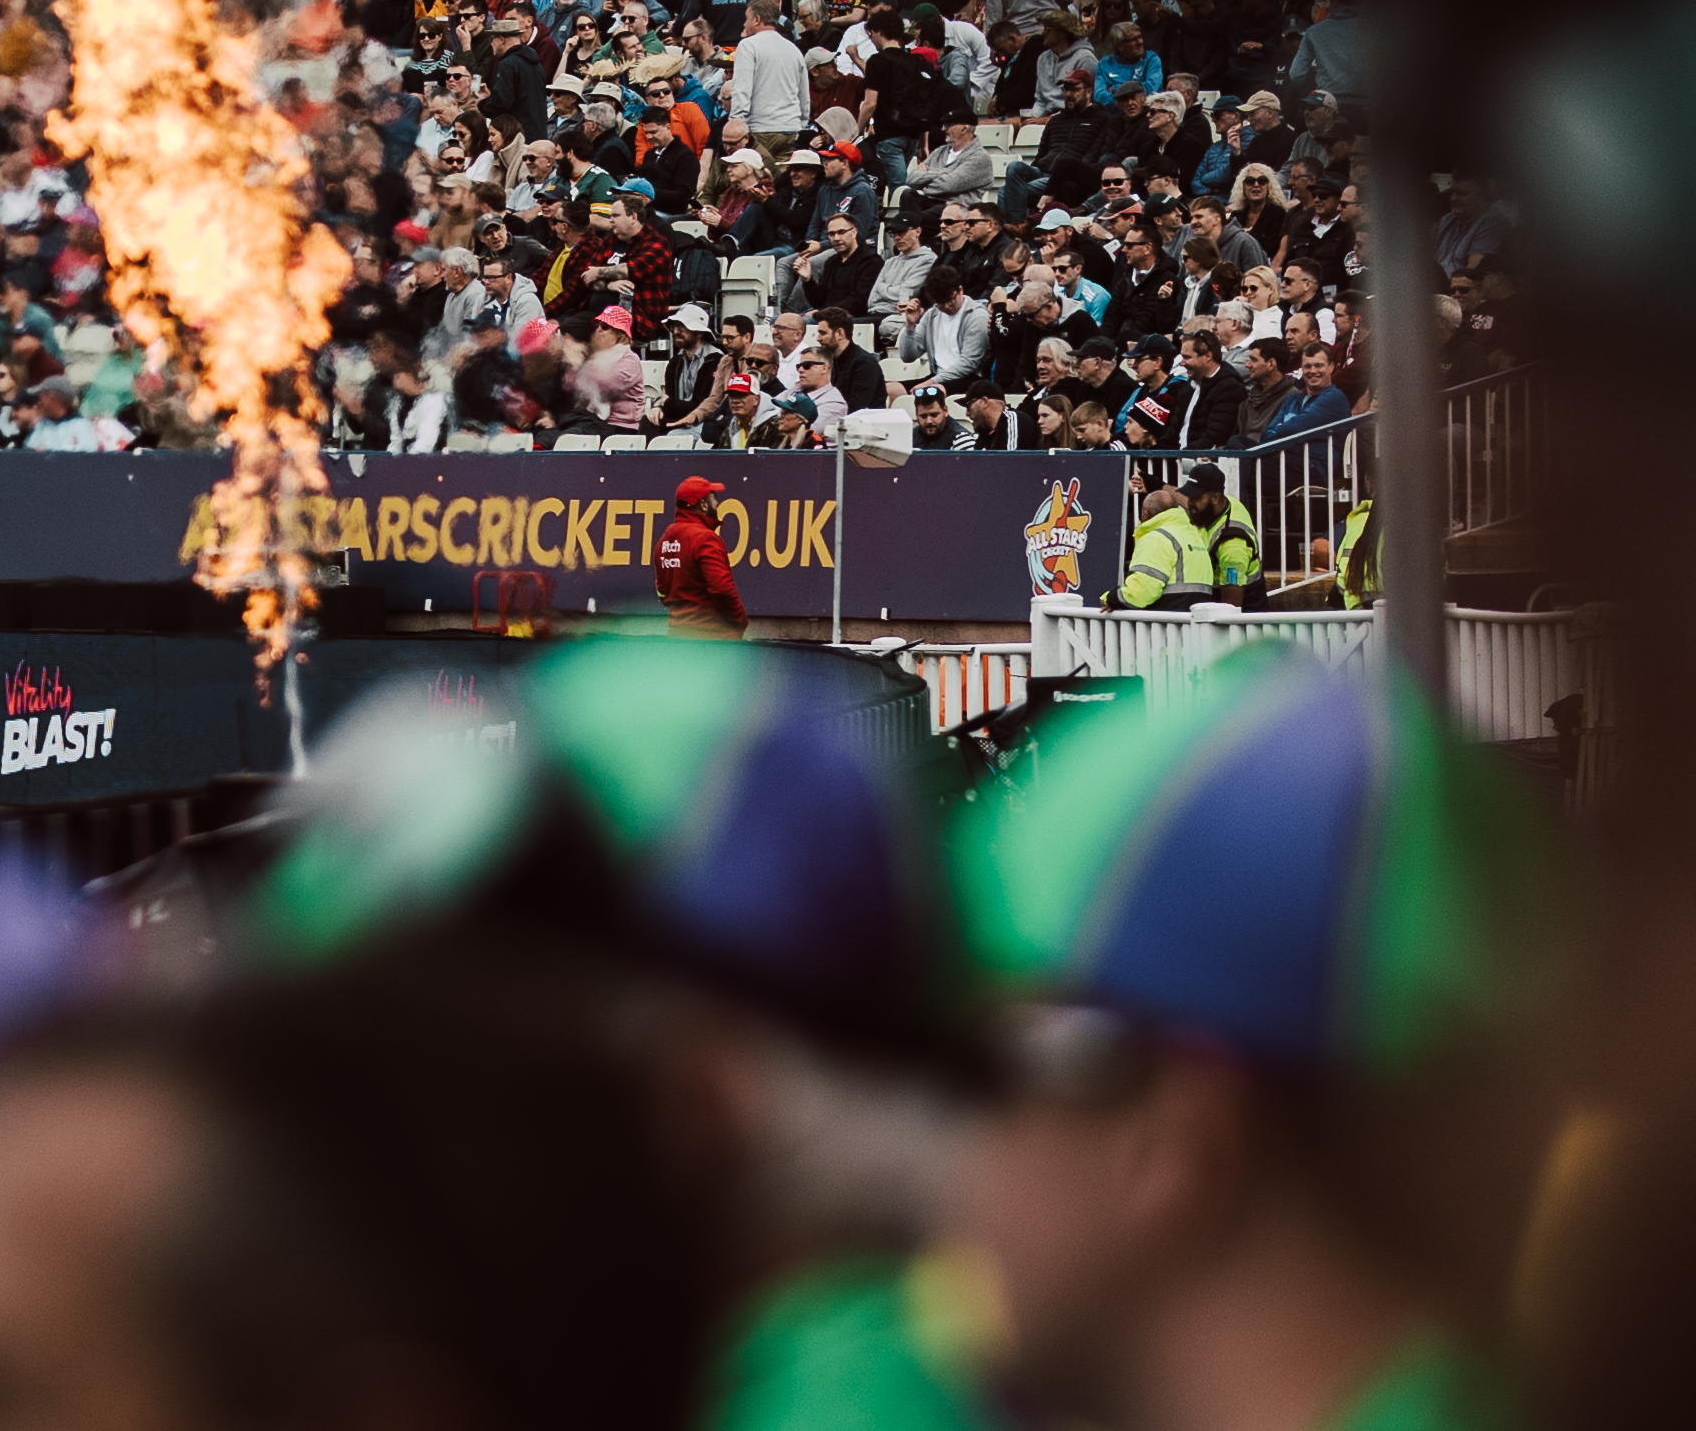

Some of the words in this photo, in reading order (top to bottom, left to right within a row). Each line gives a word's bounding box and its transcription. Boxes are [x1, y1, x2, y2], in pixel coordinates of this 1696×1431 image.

[1029, 529, 1052, 552] ALL
[1050, 527, 1087, 552] STARS
[5, 661, 73, 720] Vitality
[1, 708, 116, 775] BLAST!
